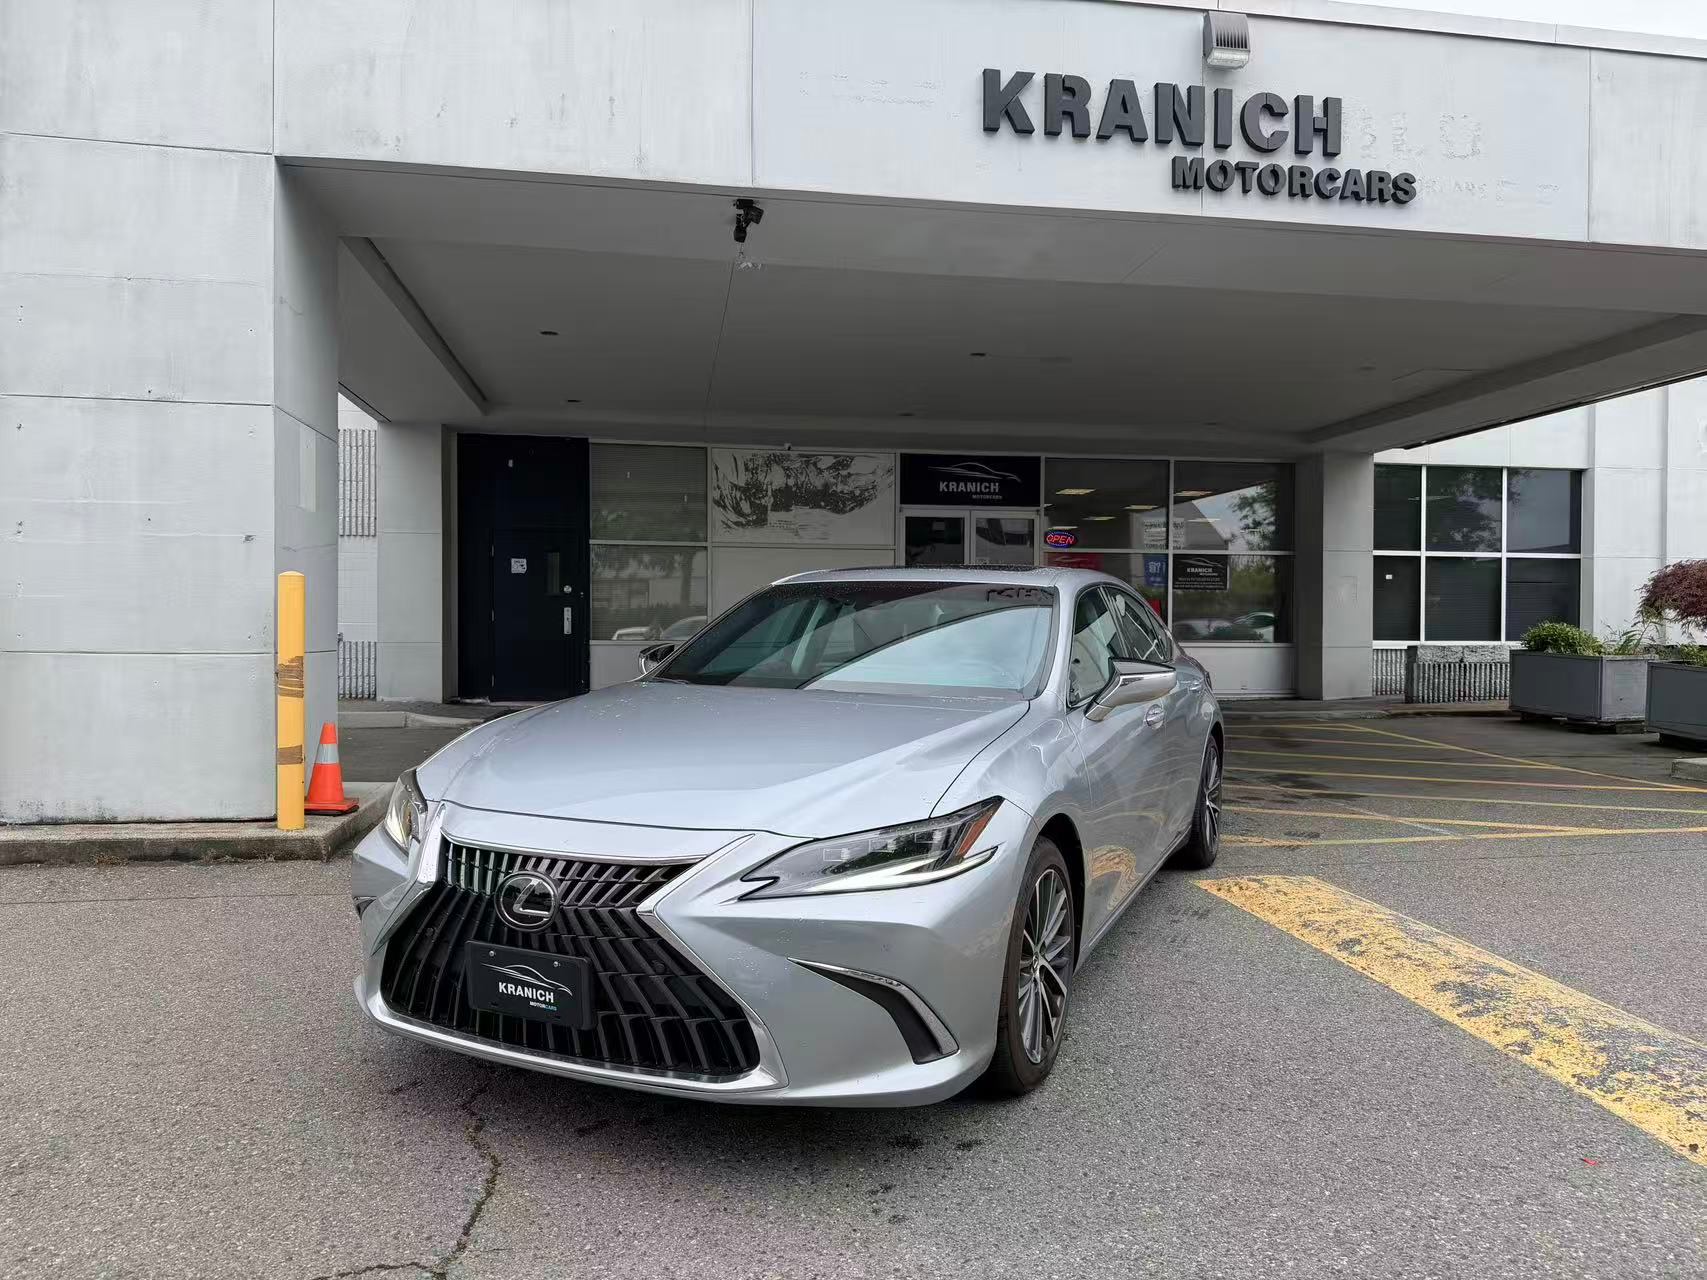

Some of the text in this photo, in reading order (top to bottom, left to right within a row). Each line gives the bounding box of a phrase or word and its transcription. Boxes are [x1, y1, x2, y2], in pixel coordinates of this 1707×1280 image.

[982, 68, 1342, 157] KRANICH
[1171, 155, 1417, 204] MOTORCARS
[939, 481, 999, 493] KRANICH
[1046, 533, 1075, 545] OPEN
[498, 981, 554, 1003] KRANICH
